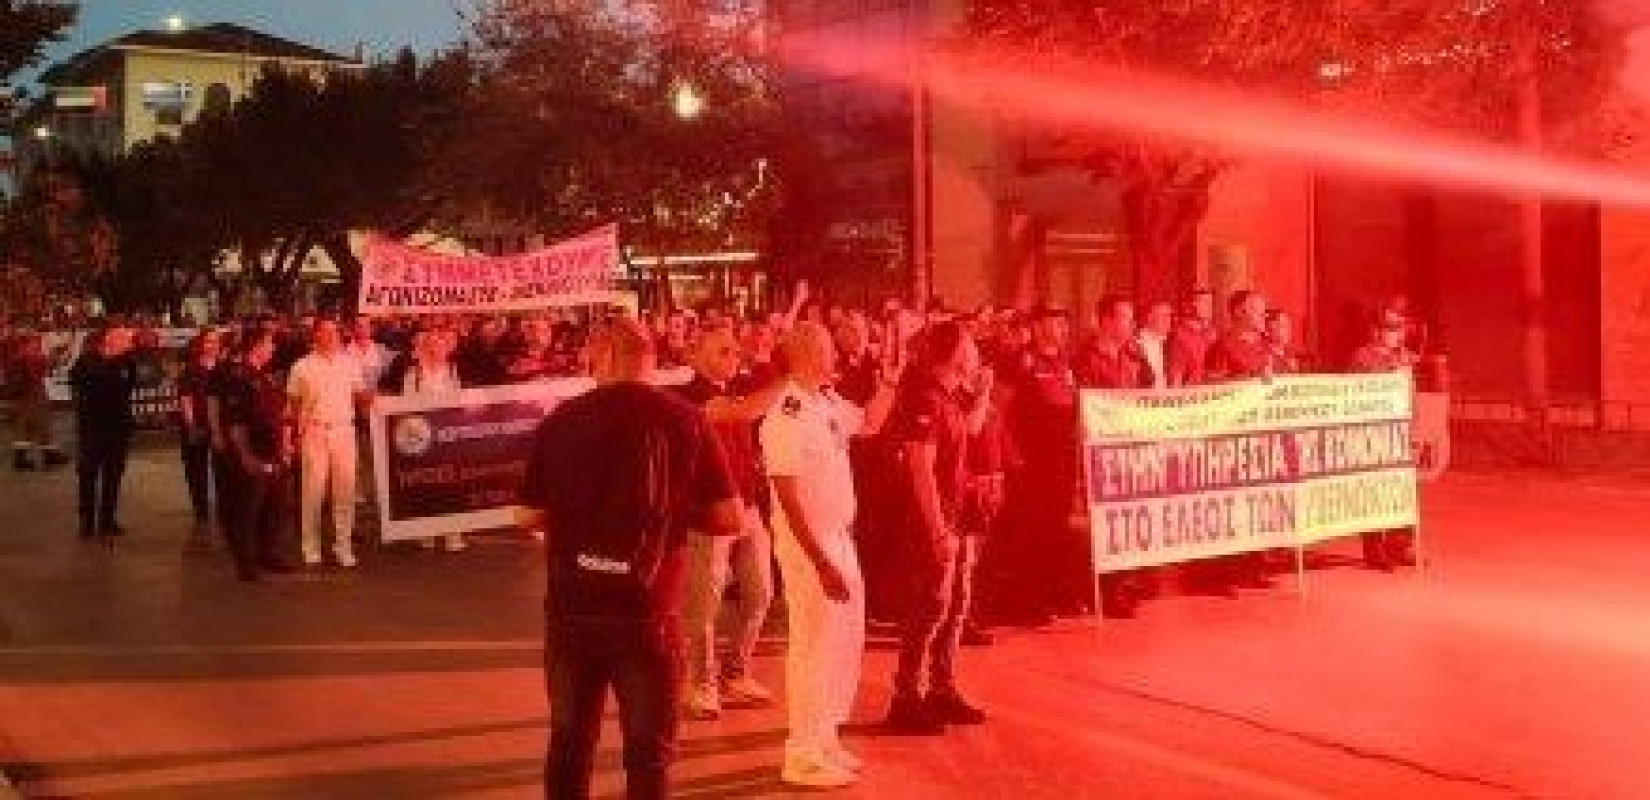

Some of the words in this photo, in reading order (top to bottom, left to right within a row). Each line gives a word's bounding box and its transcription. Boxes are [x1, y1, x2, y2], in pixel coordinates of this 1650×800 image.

[1177, 433, 1289, 487] ΥΠΗΡΕΣΙΑ
[1106, 505, 1153, 555] ΣΤΟ
[1162, 494, 1236, 548] ΕΛΕΟΣ
[1246, 488, 1296, 537] ΤΩΝ
